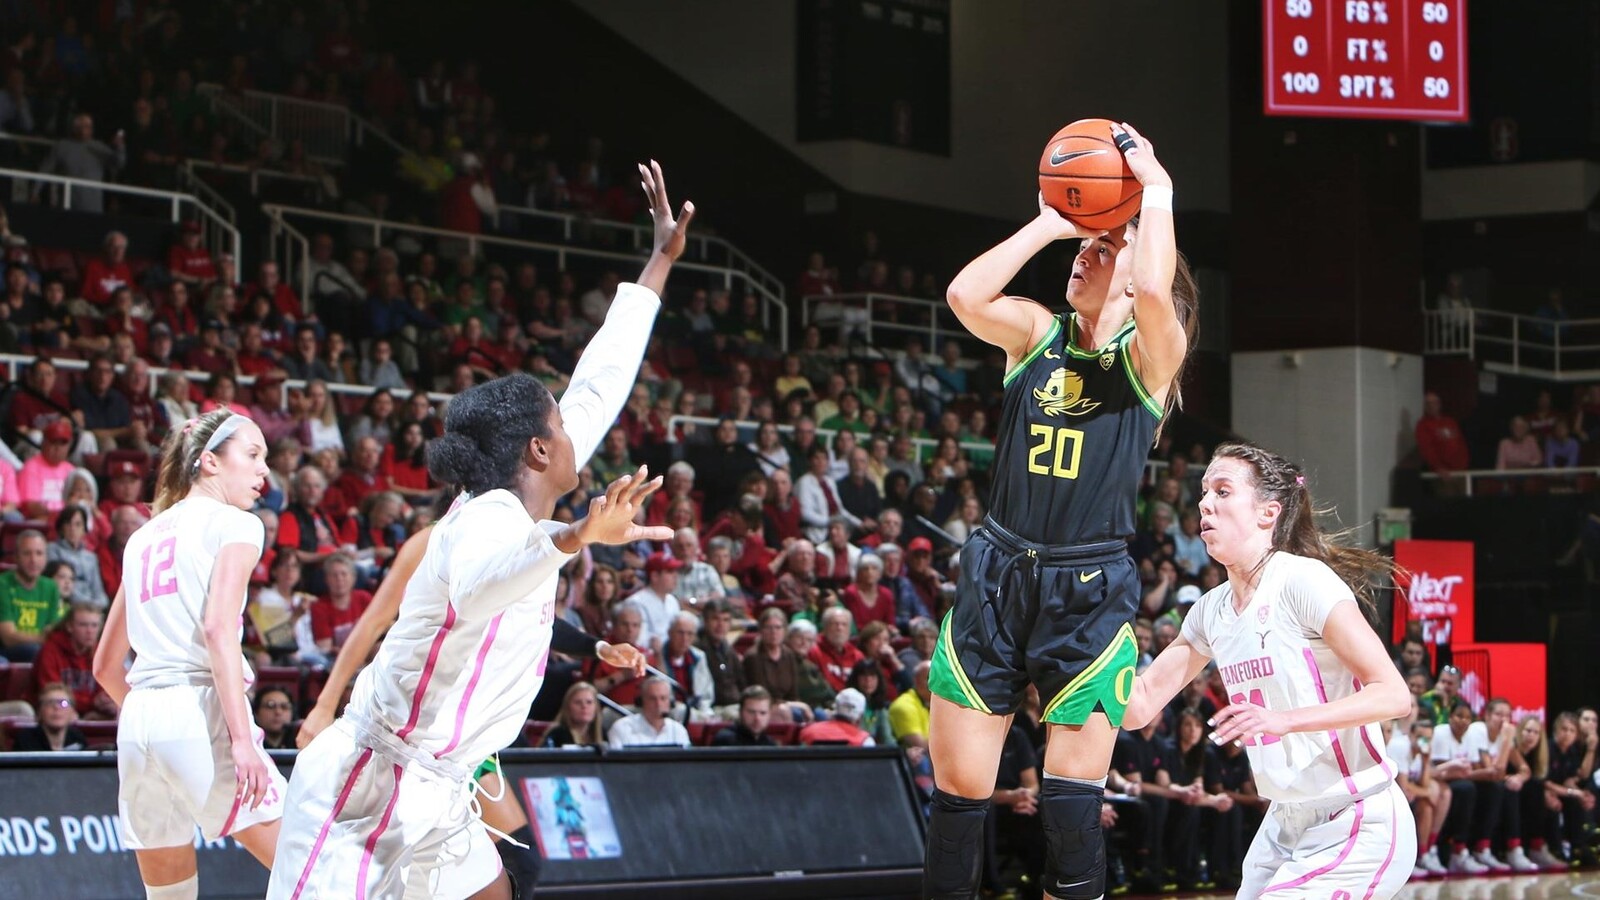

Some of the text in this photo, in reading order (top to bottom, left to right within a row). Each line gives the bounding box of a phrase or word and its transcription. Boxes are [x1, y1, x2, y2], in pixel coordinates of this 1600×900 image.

[1286, 0, 1449, 24] 50 FG % 50
[1293, 35, 1444, 62] 0 FT % 0
[1282, 72, 1320, 94] 100
[1379, 77, 1395, 99] %
[1424, 77, 1450, 98] 50
[1028, 423, 1085, 480] 20
[139, 536, 178, 604] 12
[1220, 656, 1275, 687] TANFORD
